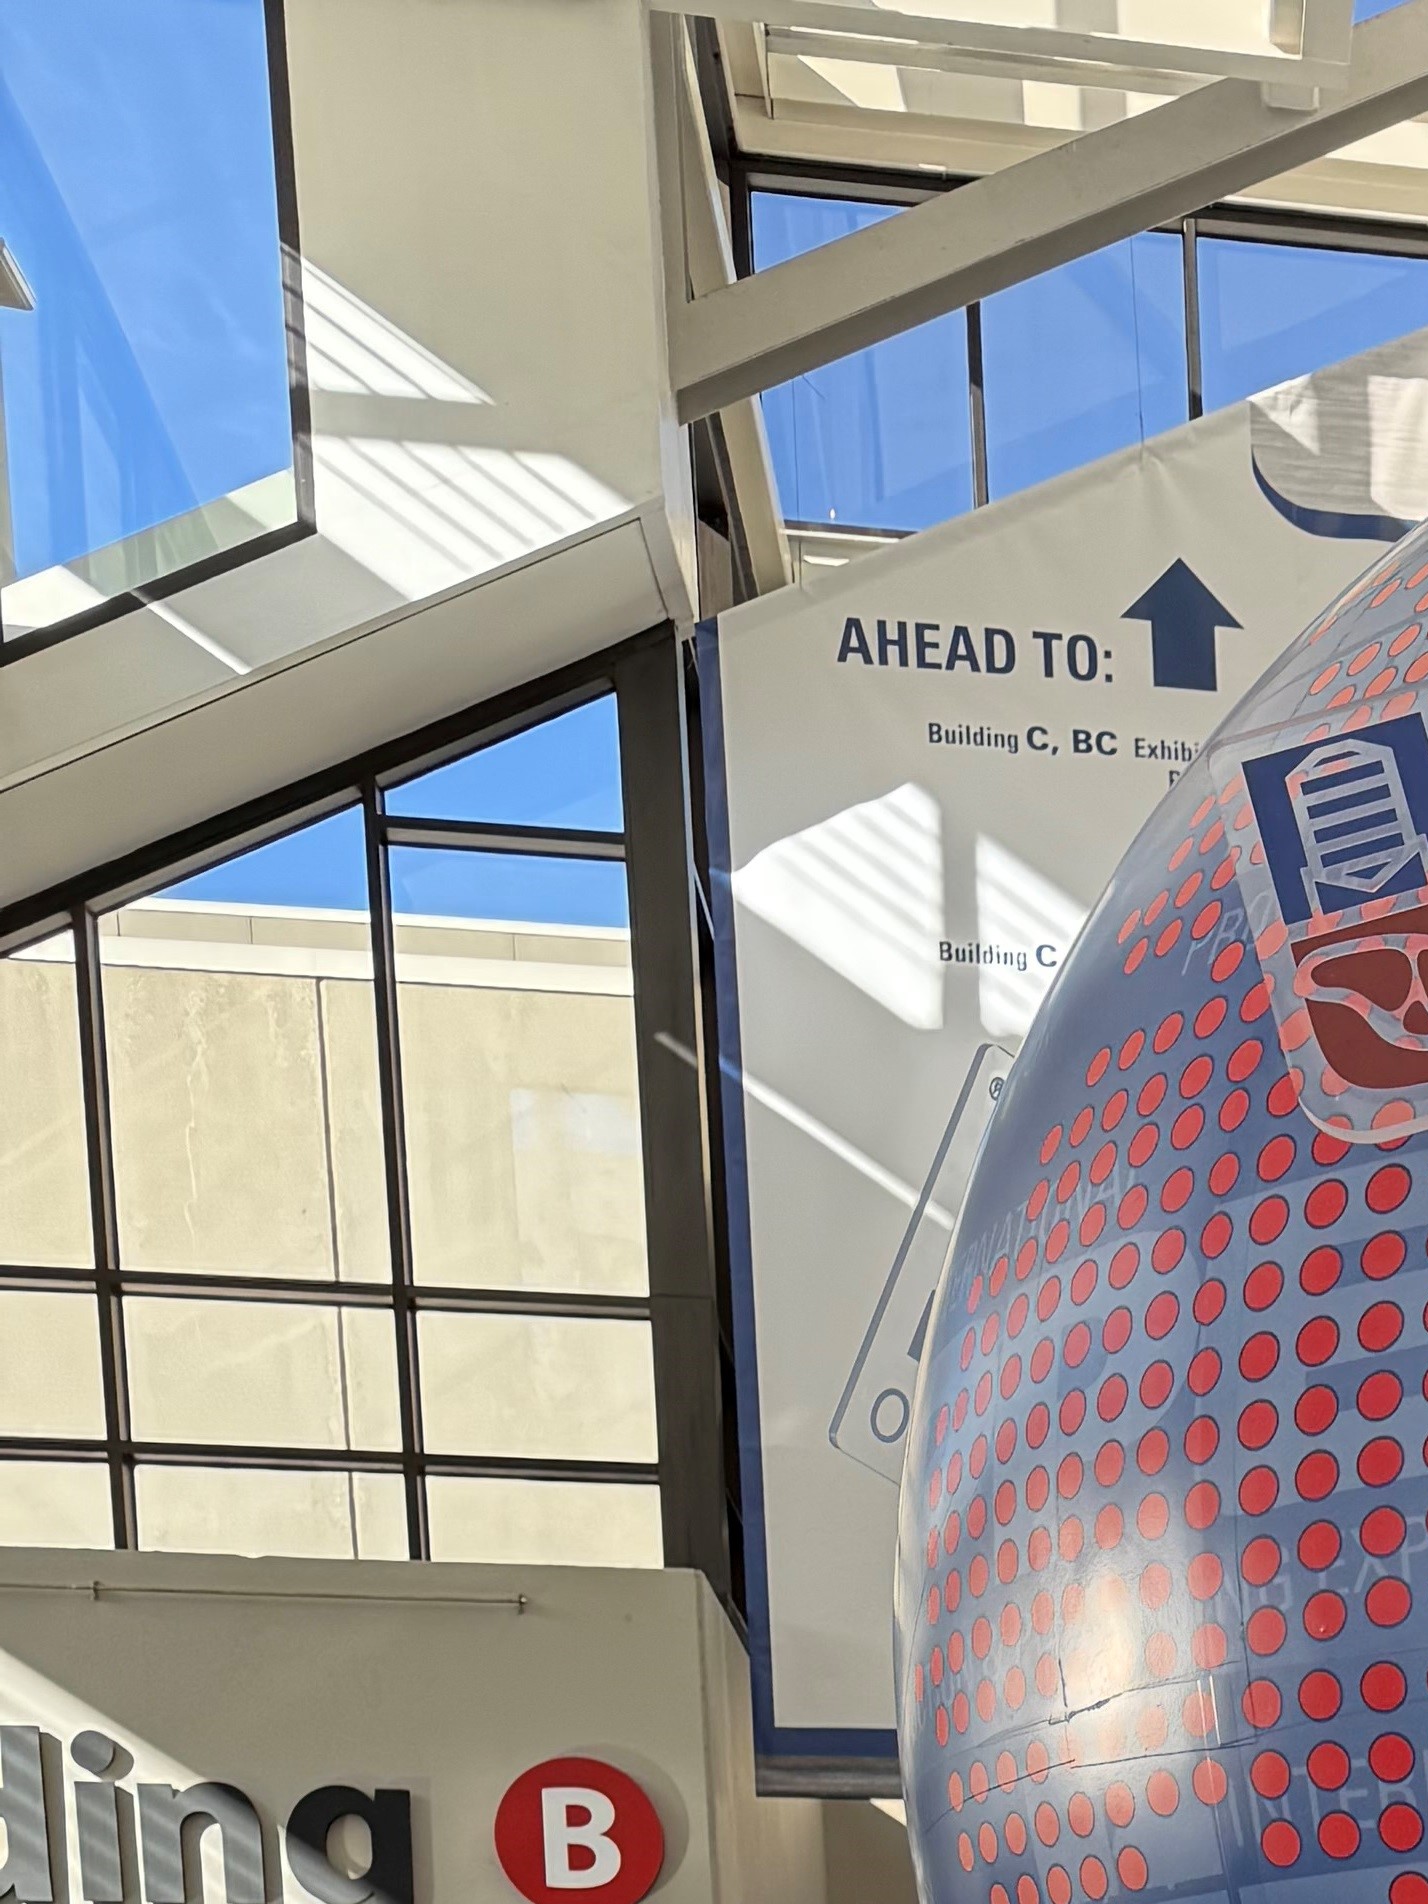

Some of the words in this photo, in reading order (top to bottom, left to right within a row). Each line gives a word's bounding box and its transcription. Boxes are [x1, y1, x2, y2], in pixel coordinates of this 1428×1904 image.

[836, 616, 1016, 676] AHEAD
[1032, 630, 1115, 683] TO:
[928, 722, 1020, 754] Building
[1026, 726, 1060, 758] C,
[1072, 729, 1119, 757] BC
[939, 941, 1028, 971] Building
[1036, 944, 1058, 967] C
[541, 1785, 622, 1890] B
